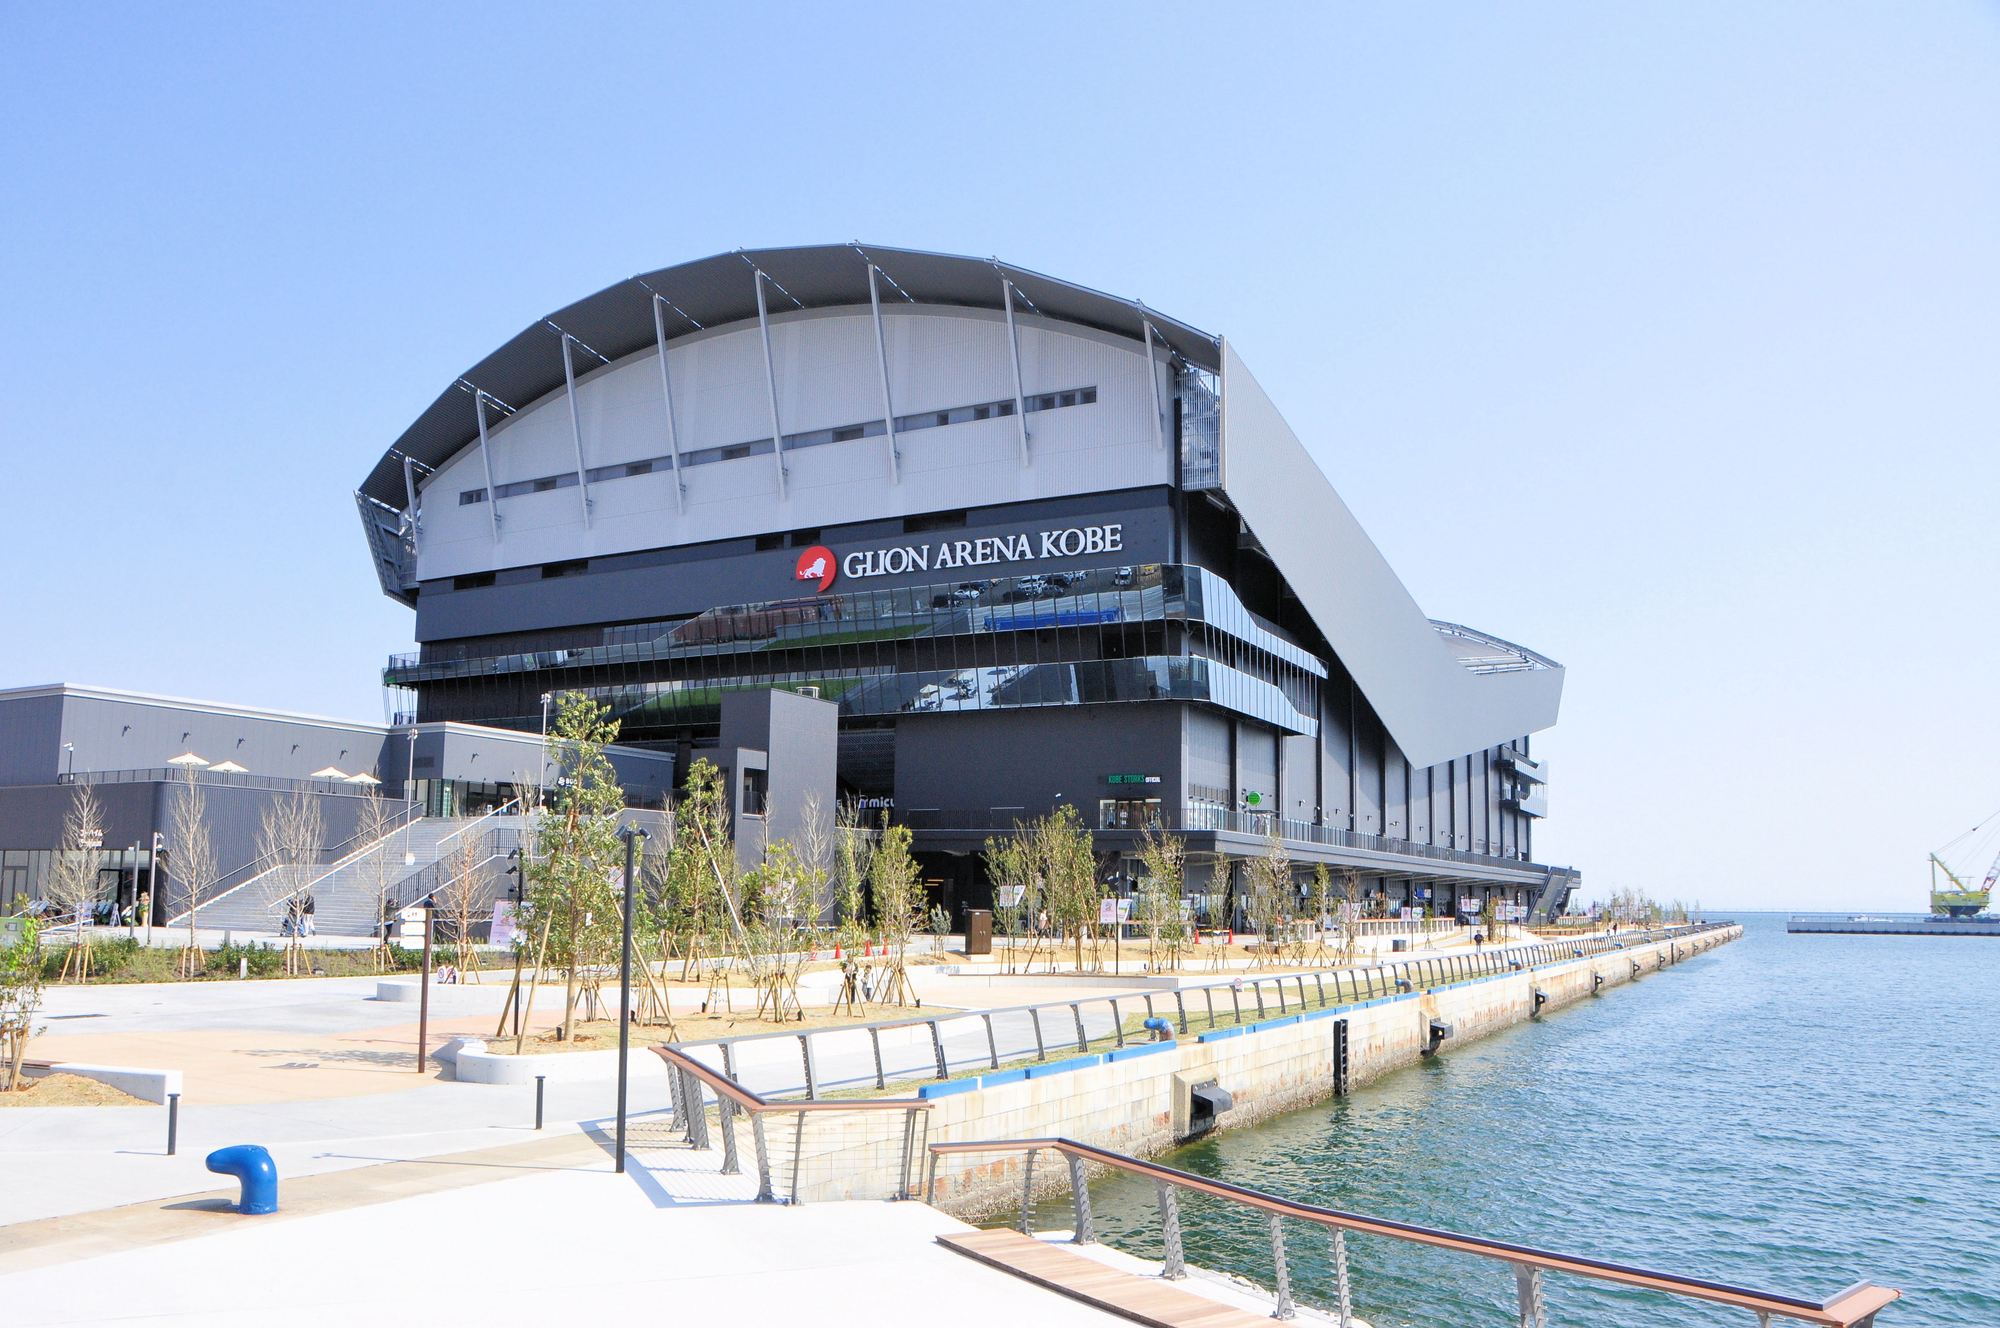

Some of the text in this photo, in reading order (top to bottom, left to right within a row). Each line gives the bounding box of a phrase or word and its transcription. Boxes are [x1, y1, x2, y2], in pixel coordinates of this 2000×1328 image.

[843, 524, 1123, 579] GLION ARENA KOBE
